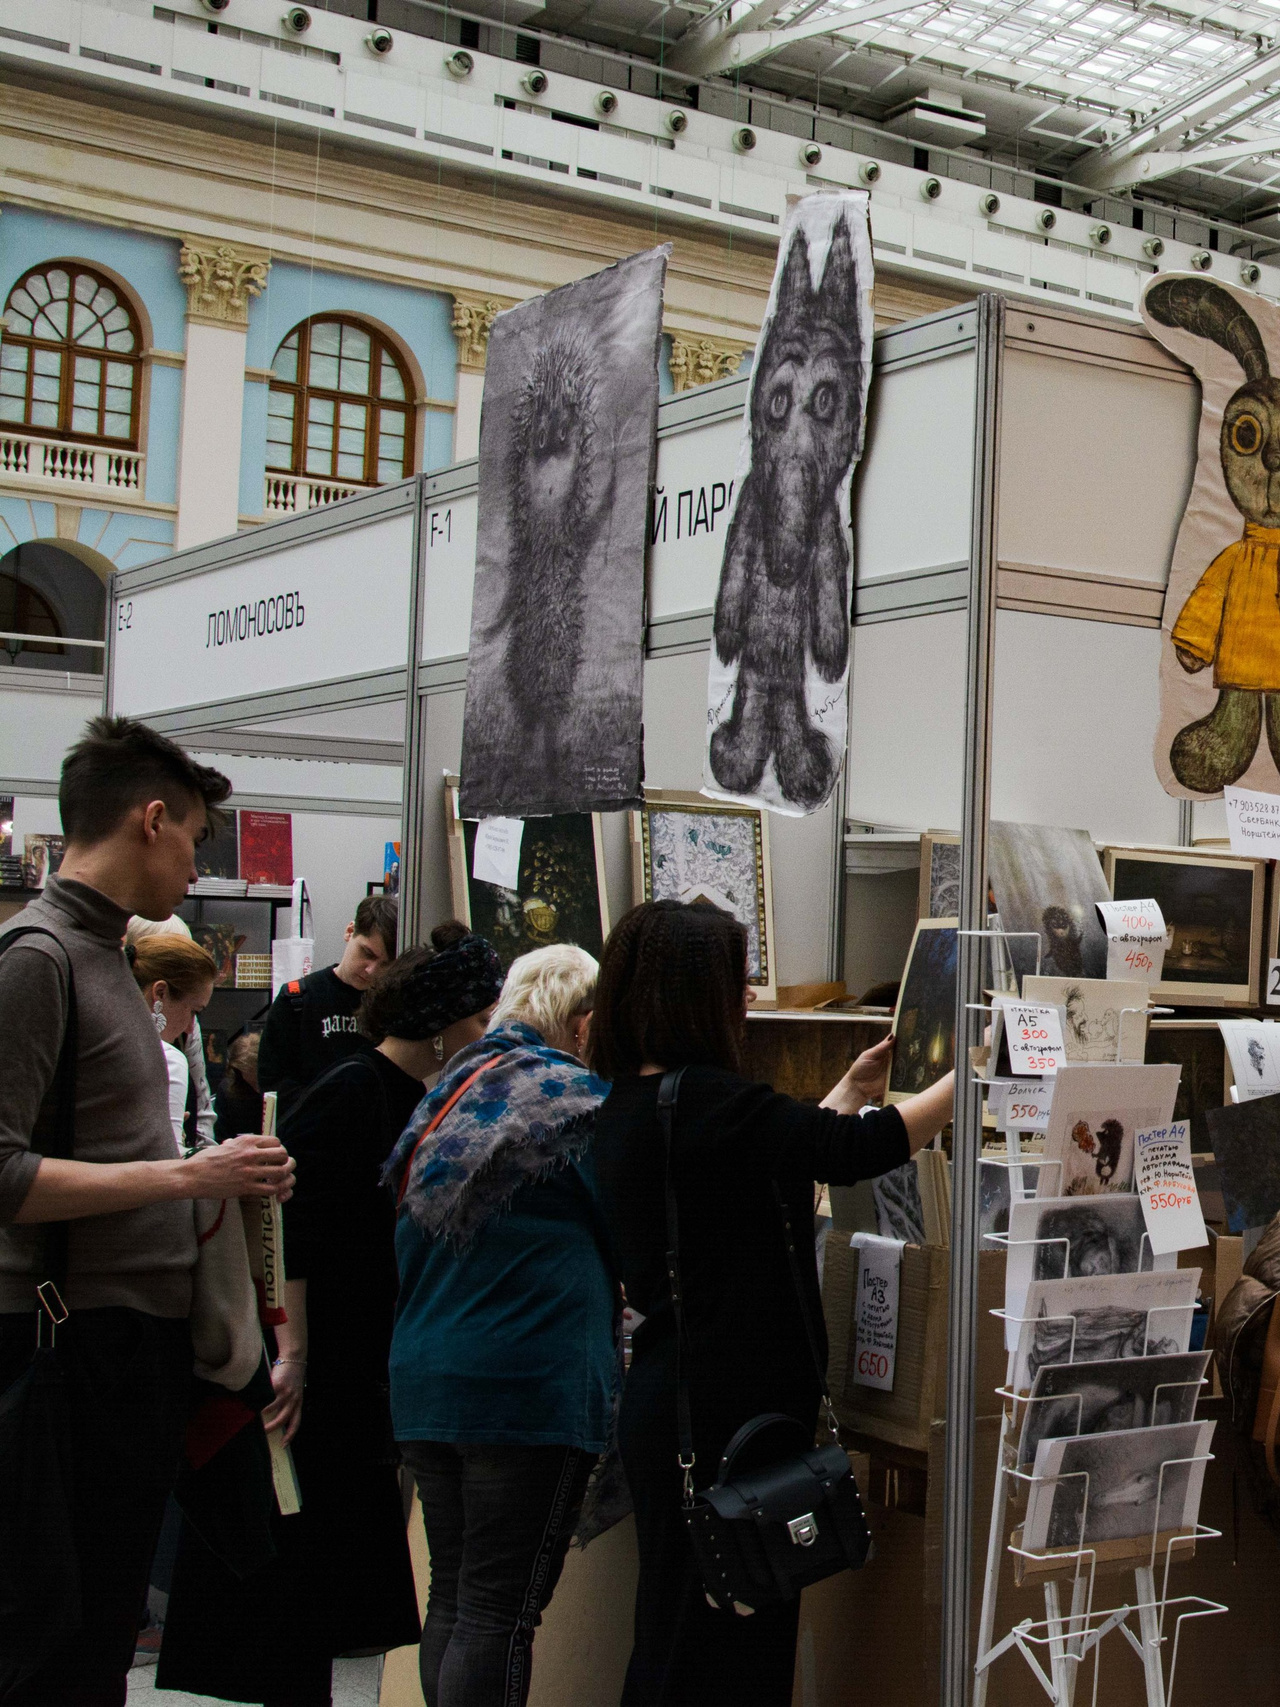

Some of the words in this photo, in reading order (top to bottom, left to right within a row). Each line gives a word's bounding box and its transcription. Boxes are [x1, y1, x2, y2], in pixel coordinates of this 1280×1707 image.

[652, 486, 668, 545] Й
[431, 509, 452, 547] F-1
[118, 602, 133, 632] E-2
[206, 591, 306, 648] ЛОМОНОСОВЪ
[1228, 800, 1238, 808] +7
[1104, 903, 1137, 913] Постер
[1140, 901, 1156, 913] А4
[1120, 933, 1162, 946] автографом
[321, 1014, 358, 1038] para
[1017, 1013, 1038, 1027] А5
[1021, 1029, 1048, 1040] 300
[1020, 1045, 1063, 1055] автографом
[1027, 1056, 1056, 1069] 350
[1138, 1129, 1167, 1146] Постер
[1169, 1124, 1186, 1138] А4
[261, 1194, 275, 1303] non/ficti
[863, 1268, 888, 1289] Постер
[858, 1351, 888, 1379] 650
